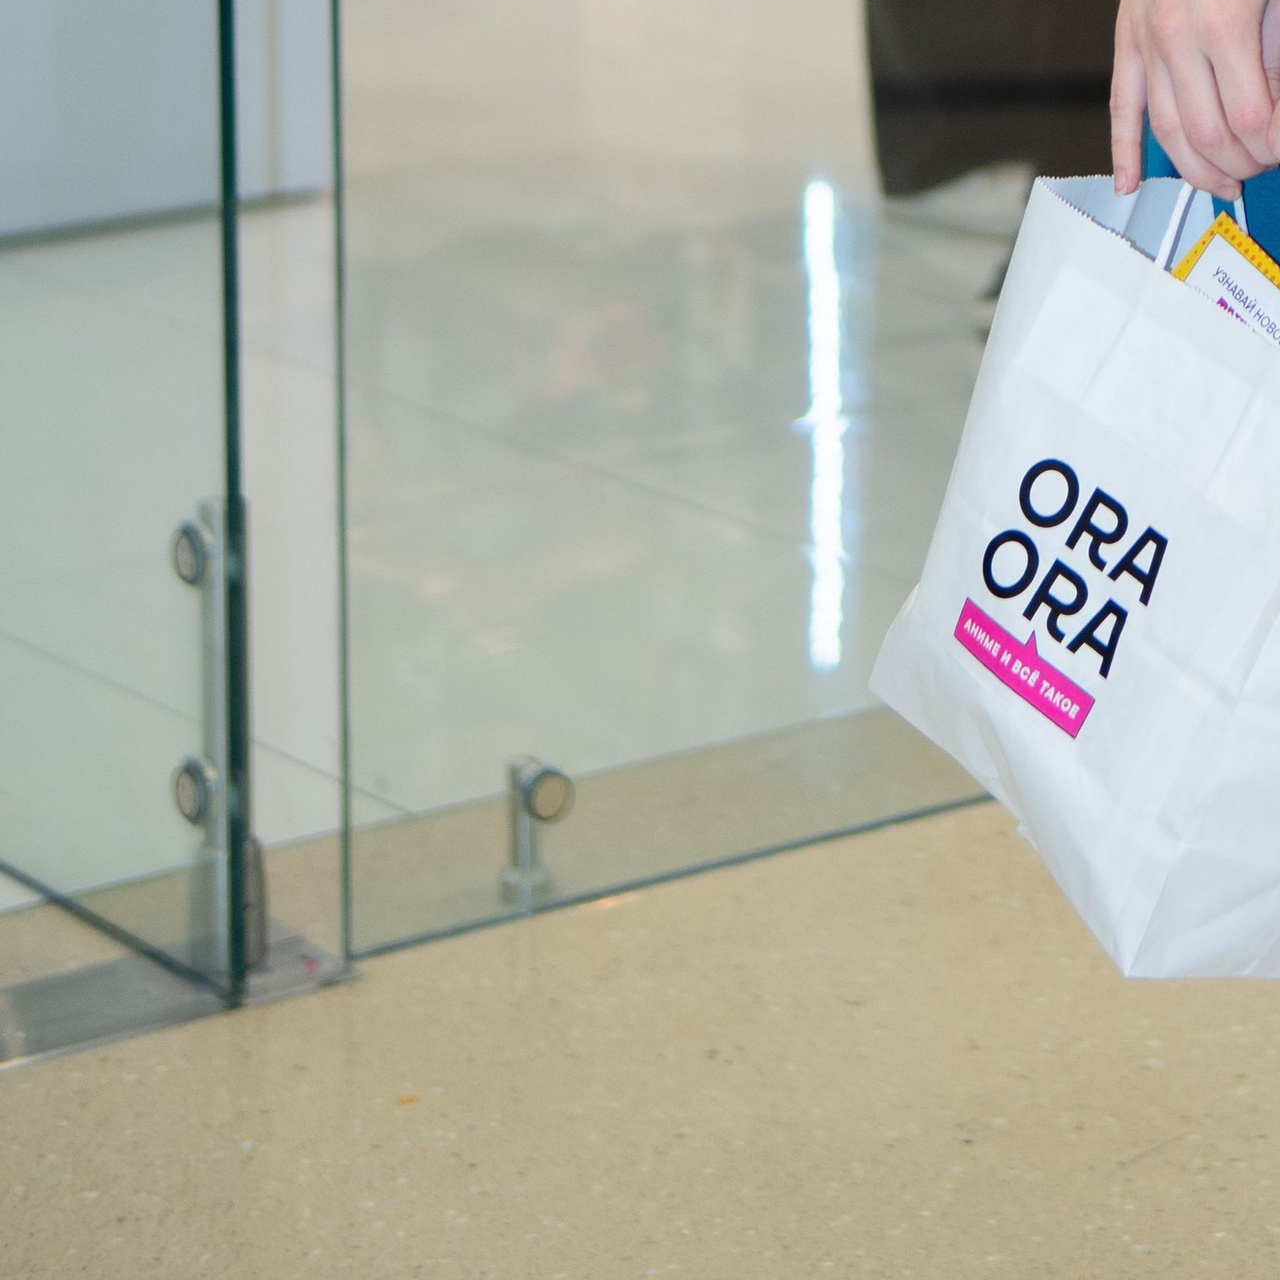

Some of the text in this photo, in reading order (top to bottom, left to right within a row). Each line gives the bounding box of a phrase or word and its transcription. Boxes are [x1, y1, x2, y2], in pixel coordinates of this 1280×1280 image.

[1212, 265, 1256, 313] УЗНАВАЙ
[1019, 458, 1169, 607] ORA
[983, 529, 1128, 680] ORA
[964, 618, 1080, 720] АНИМЕ И ВСЁ ТАКОЕ
